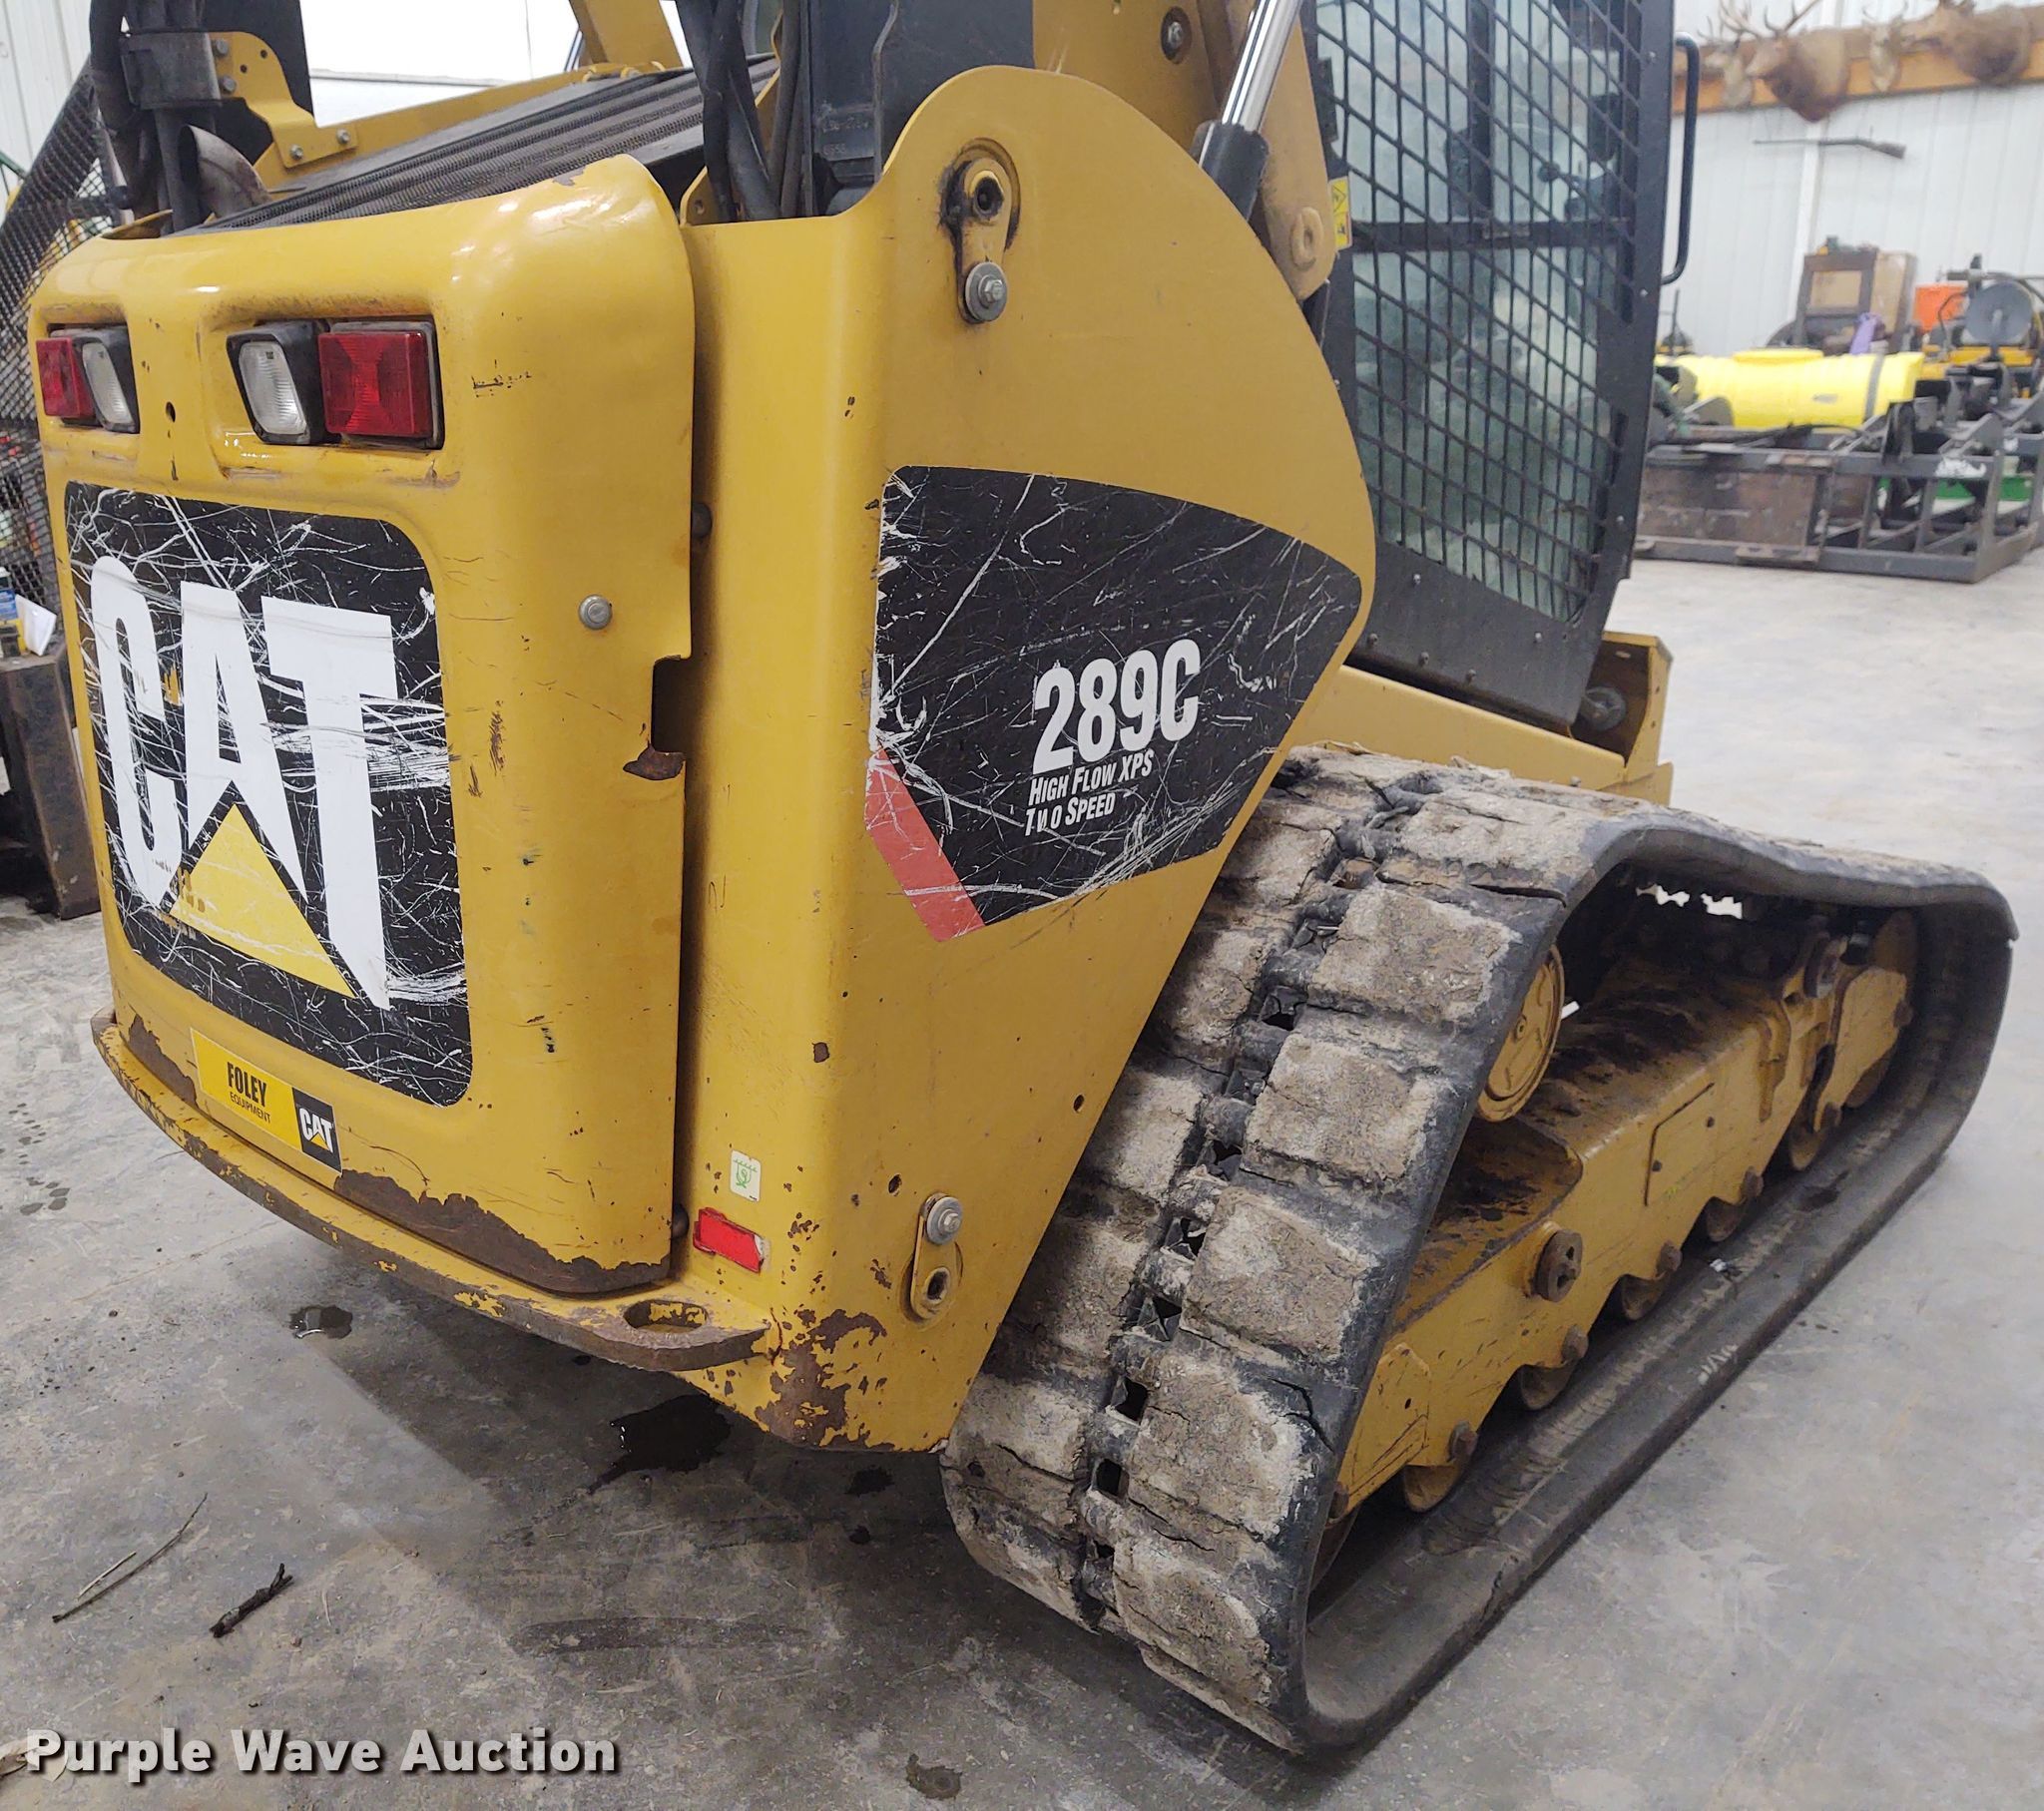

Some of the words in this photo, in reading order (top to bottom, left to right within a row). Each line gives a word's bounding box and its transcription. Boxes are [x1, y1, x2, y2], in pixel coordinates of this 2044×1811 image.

[1033, 639, 1201, 774] 289C
[91, 555, 398, 1011] CAT
[1118, 748, 1155, 783] XPS
[1065, 792, 1116, 826] SPEED
[228, 1062, 267, 1108] FOLEY
[230, 1092, 270, 1125] EQUIPMENT
[299, 1108, 333, 1152] CAT
